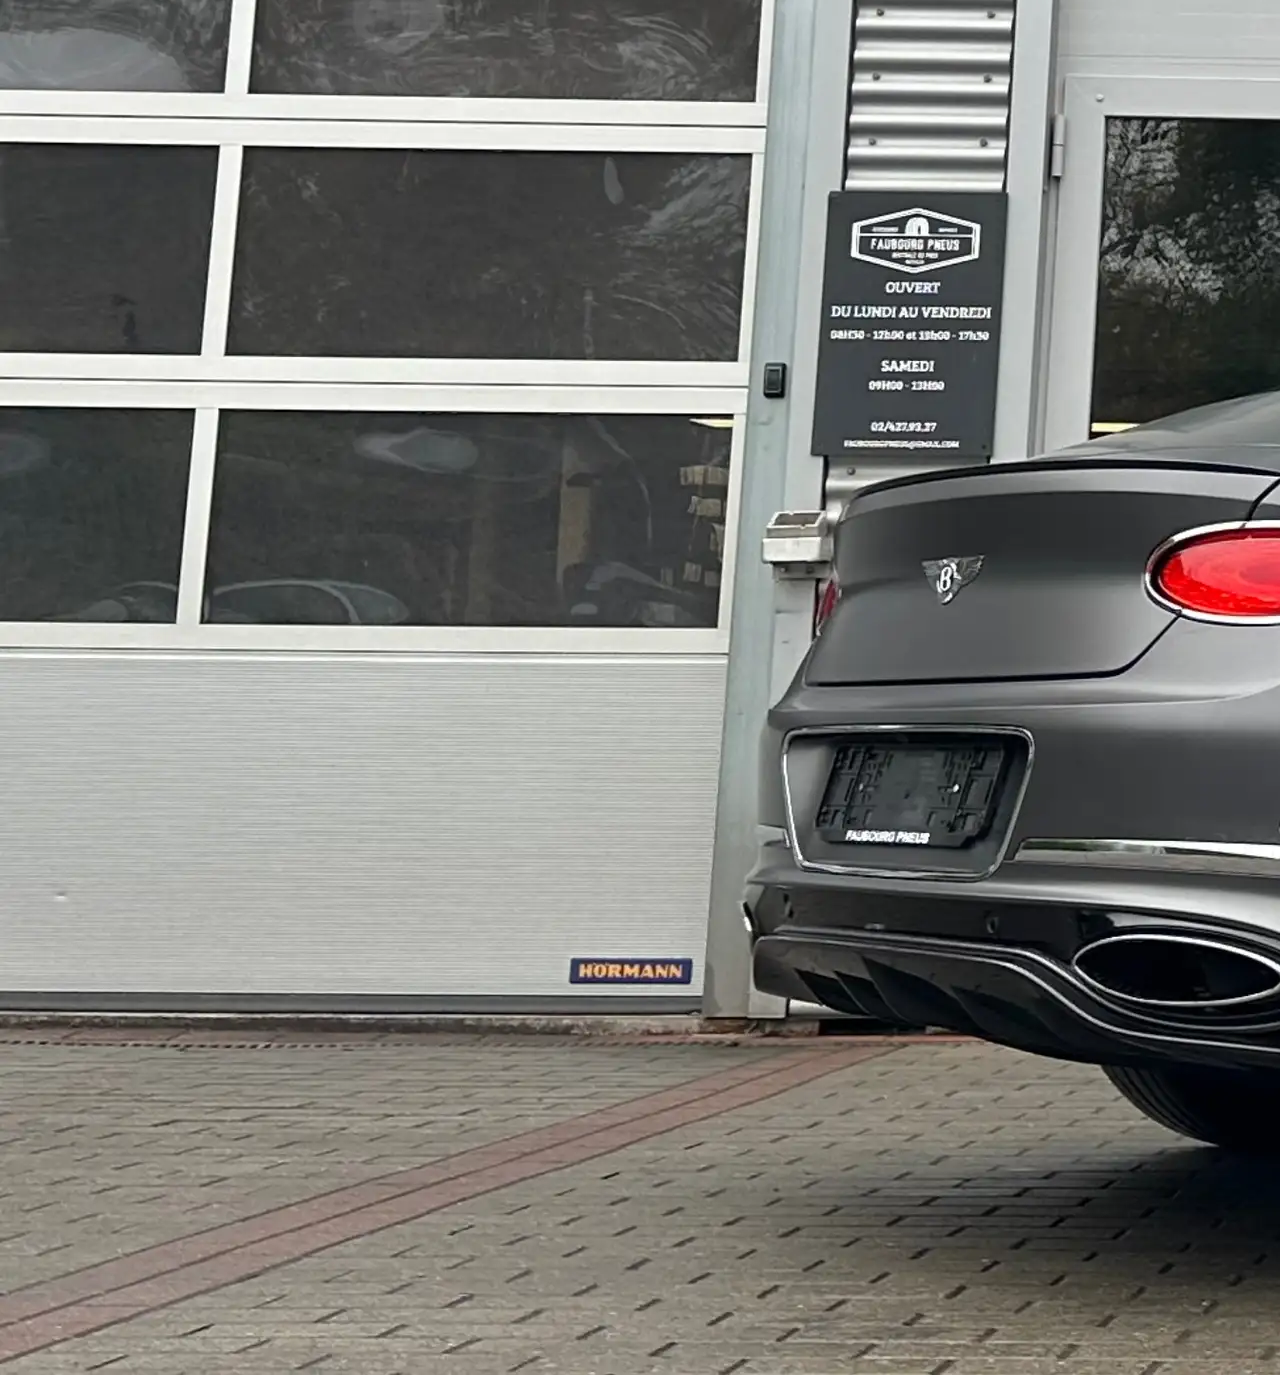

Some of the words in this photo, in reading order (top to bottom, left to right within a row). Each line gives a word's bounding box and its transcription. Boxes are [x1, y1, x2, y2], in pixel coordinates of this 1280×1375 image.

[885, 281, 941, 294] OUVERT
[830, 305, 852, 318] DU
[853, 305, 897, 319] LUNDI
[898, 306, 919, 319] AU
[920, 306, 993, 320] VENDREDI
[880, 359, 935, 373] SAMEDI
